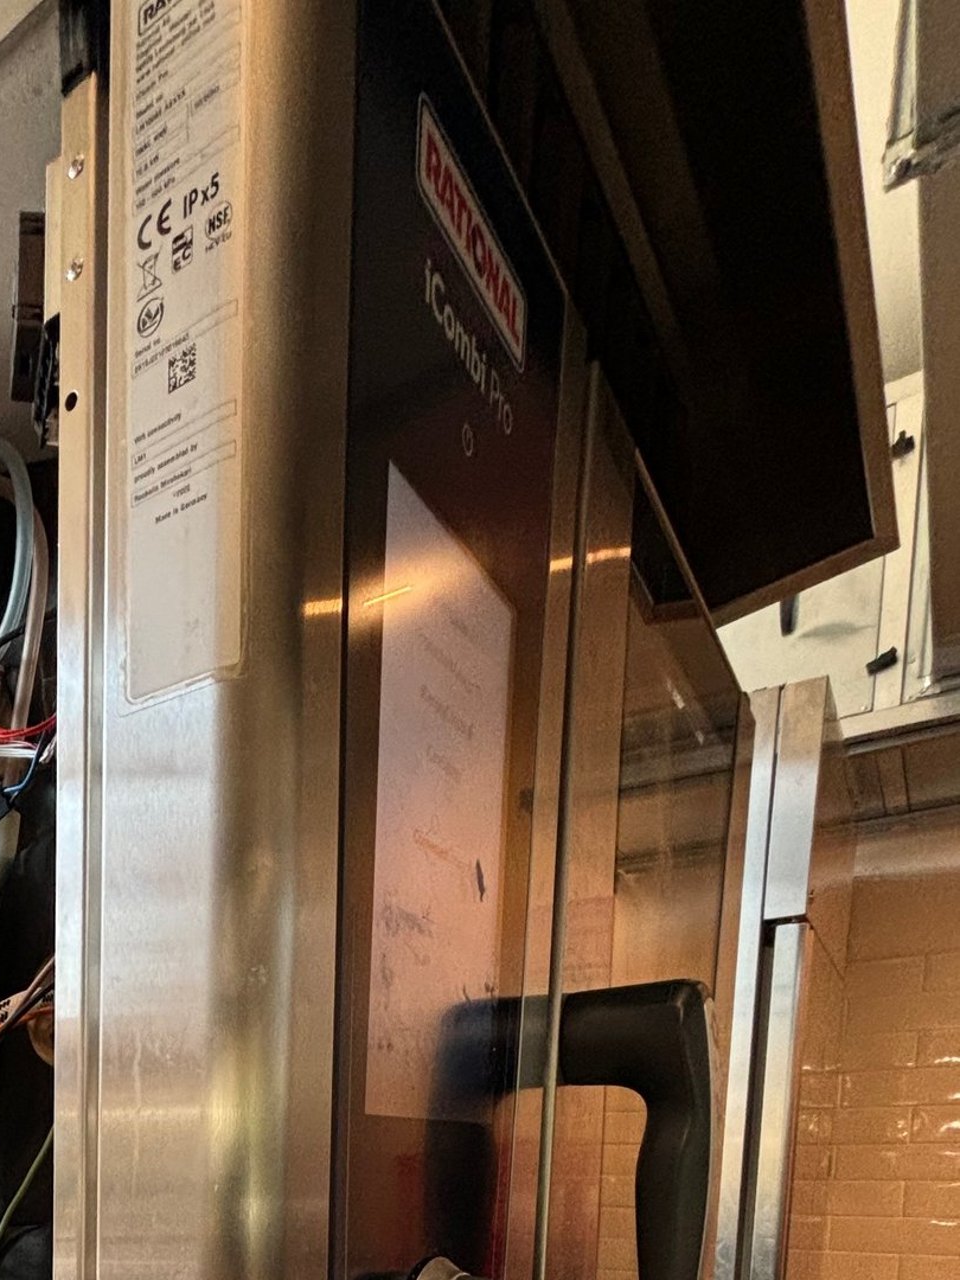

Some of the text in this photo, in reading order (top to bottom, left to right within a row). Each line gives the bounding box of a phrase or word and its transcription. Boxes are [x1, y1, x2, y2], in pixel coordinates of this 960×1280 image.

[208, 206, 230, 235] NSF
[425, 131, 520, 345] RATIONAL
[424, 257, 513, 434] iCombi Pro
[157, 448, 188, 470] assembled
[155, 511, 171, 524] Made
[180, 493, 207, 511] Germany
